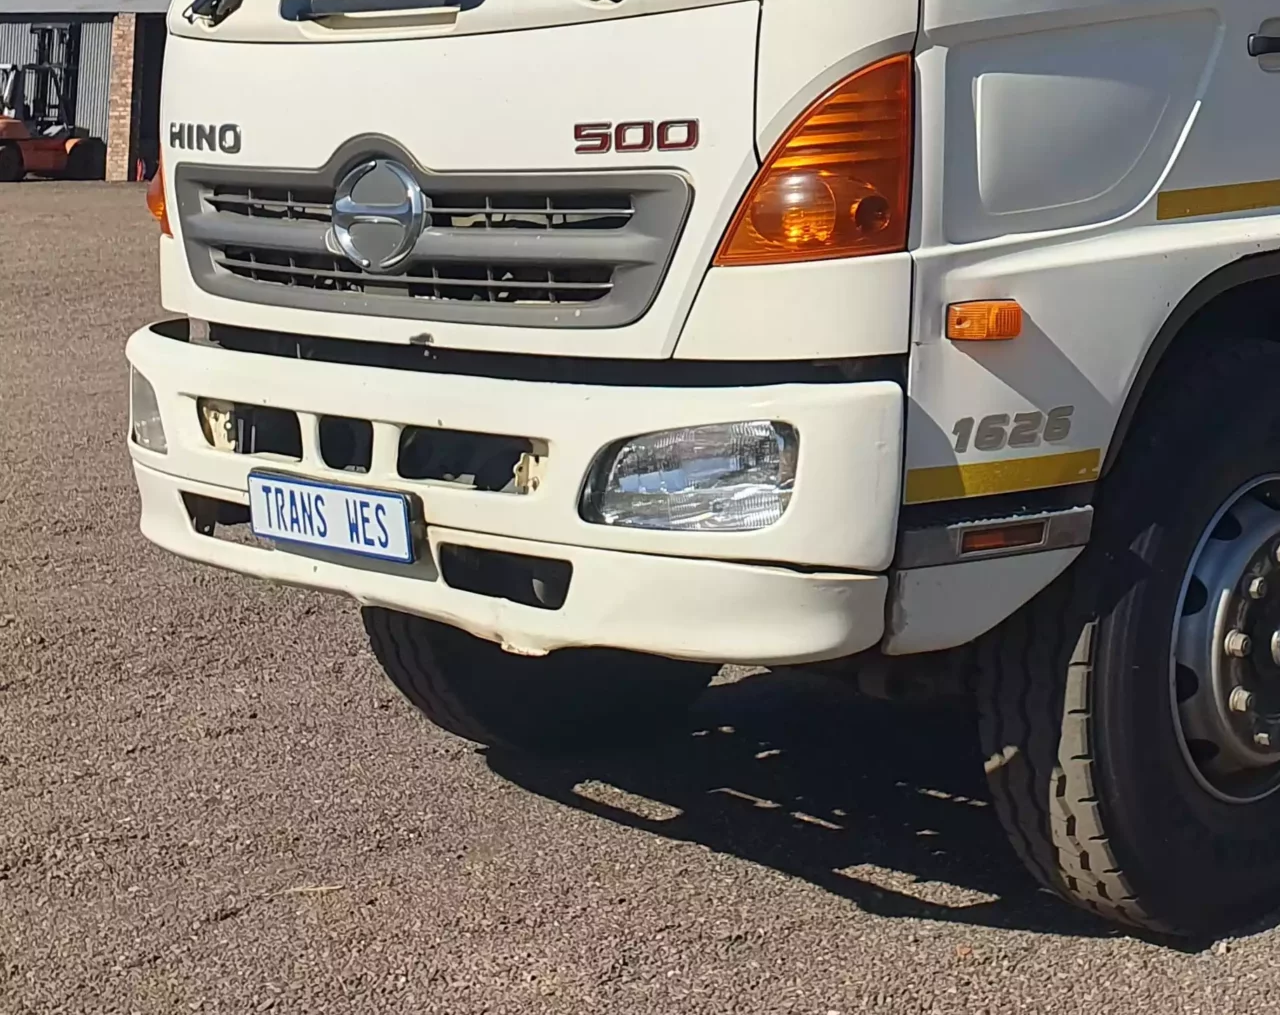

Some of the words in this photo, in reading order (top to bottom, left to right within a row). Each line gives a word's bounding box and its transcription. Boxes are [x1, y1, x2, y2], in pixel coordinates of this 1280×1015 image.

[170, 122, 242, 154] HINO
[574, 118, 700, 154] 500
[952, 405, 1076, 454] 1626
[262, 485, 328, 538] TRANS
[345, 498, 389, 549] WES
